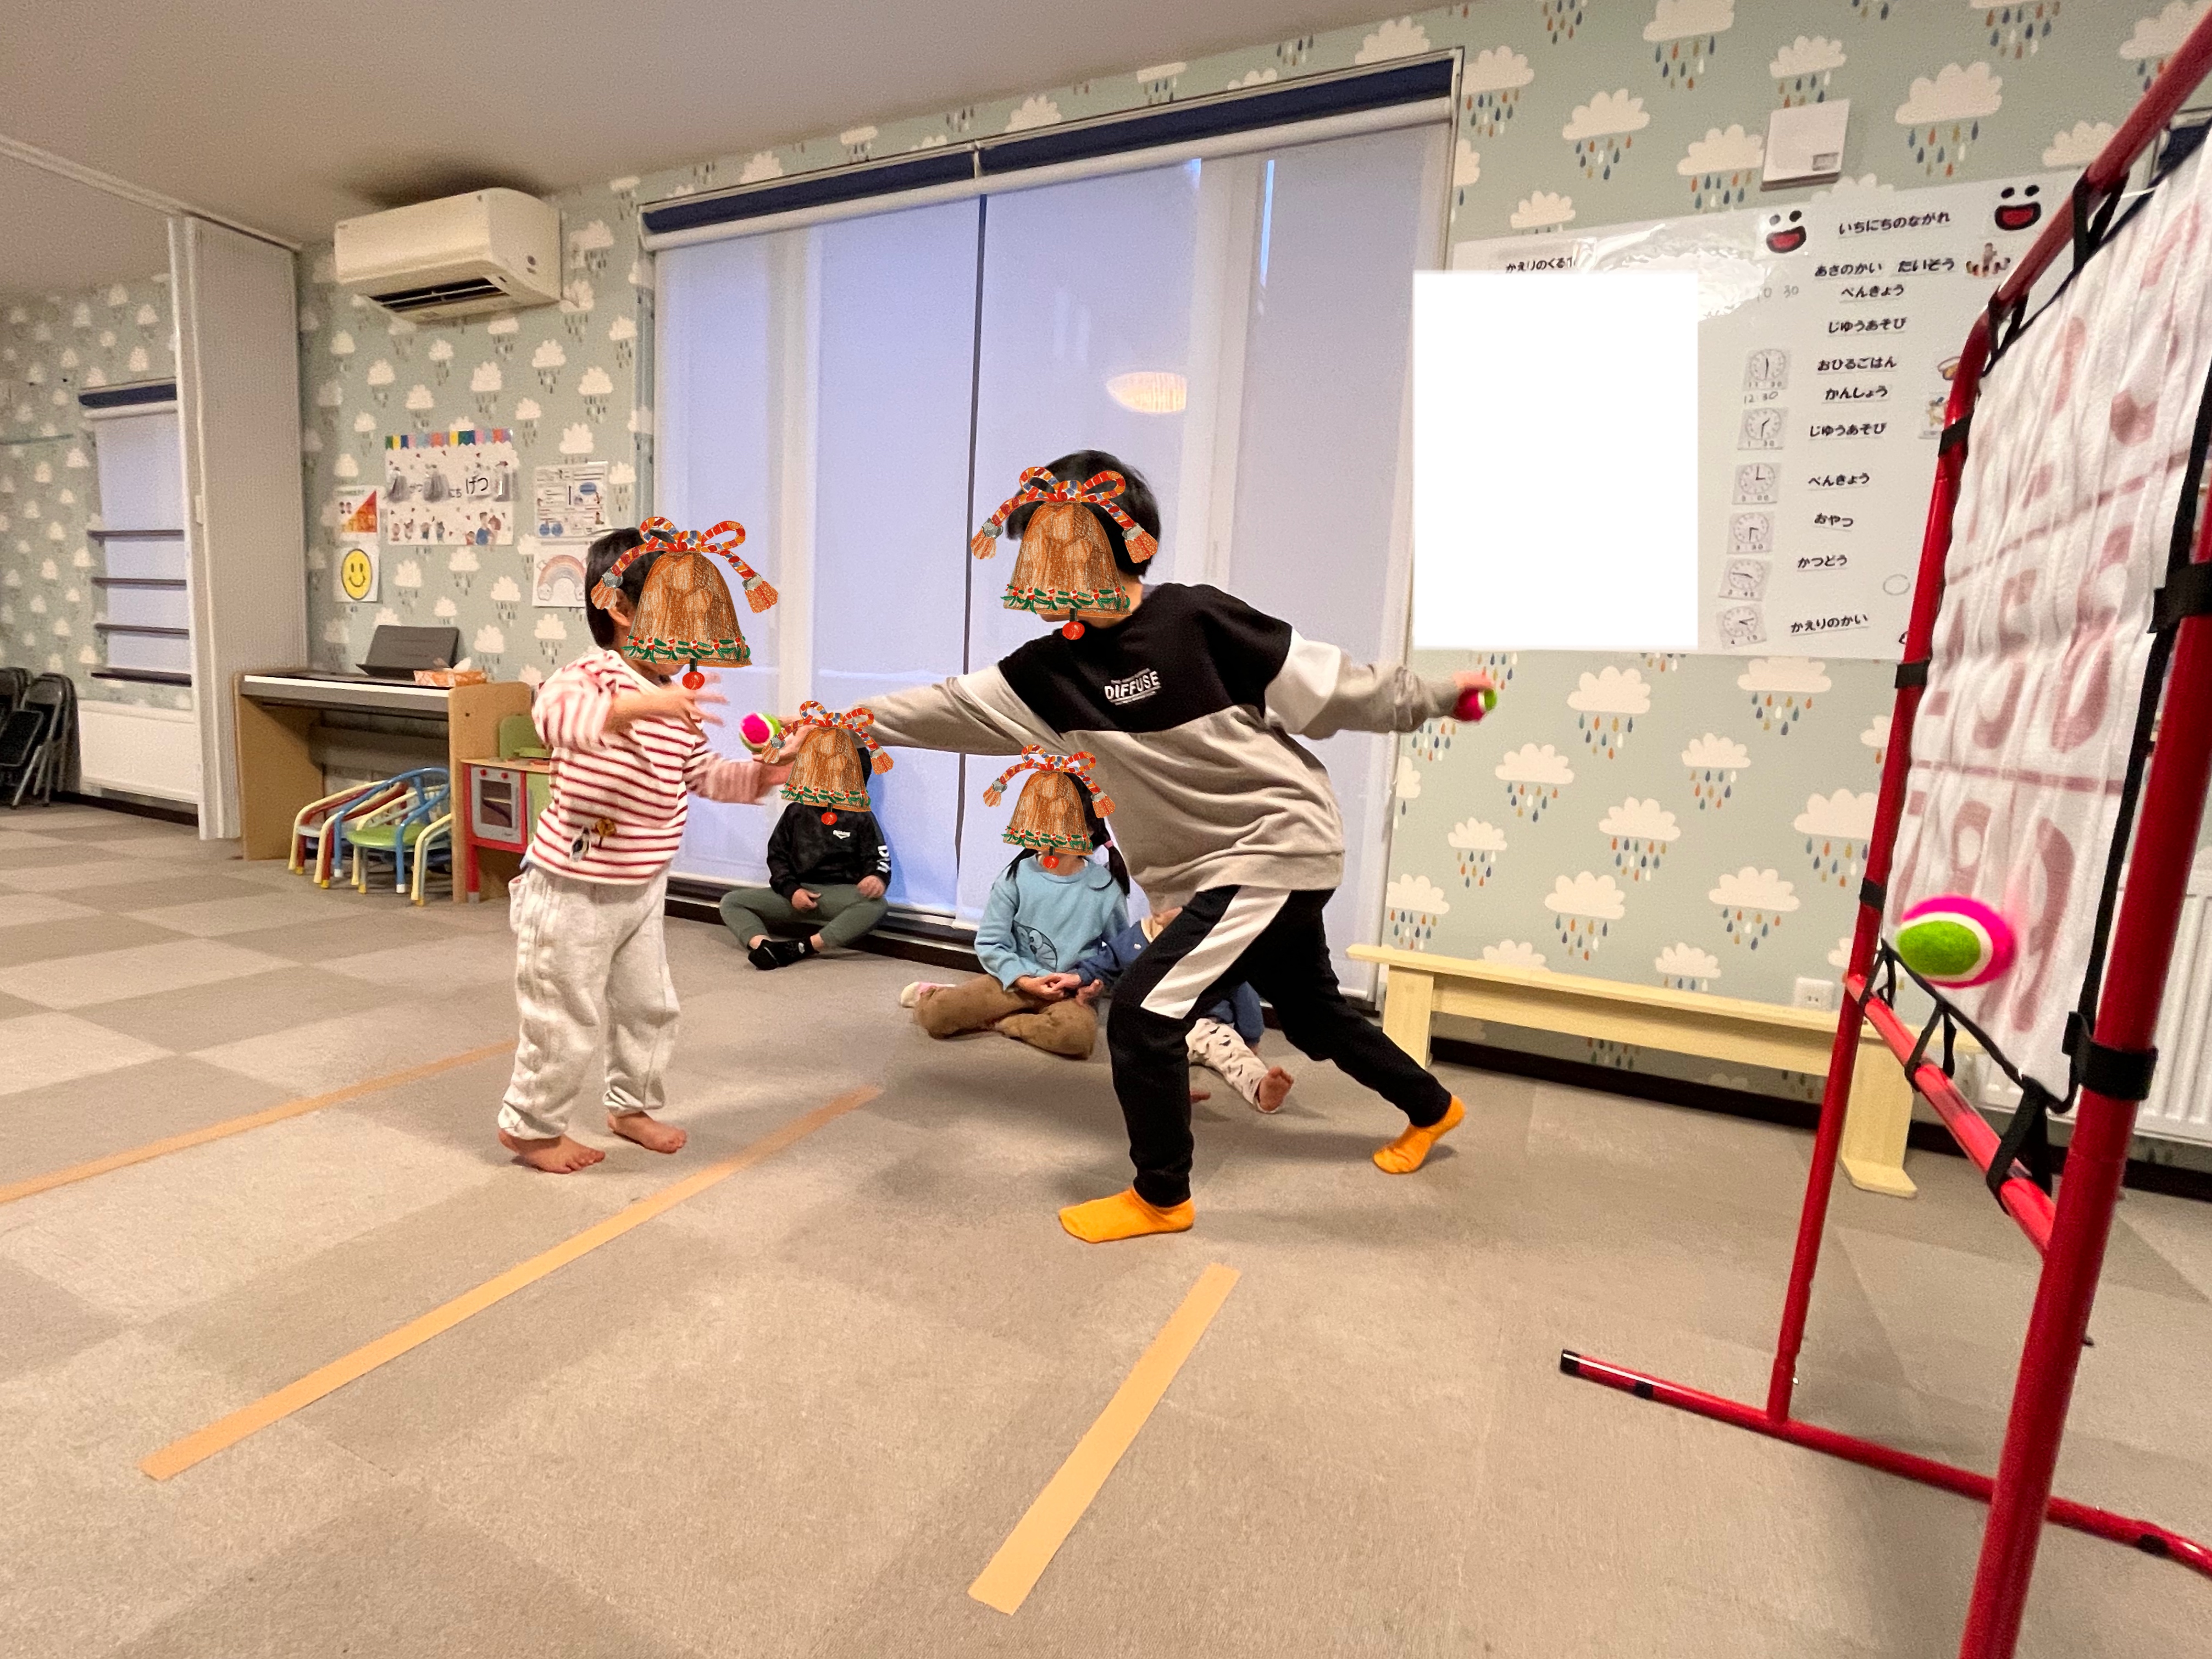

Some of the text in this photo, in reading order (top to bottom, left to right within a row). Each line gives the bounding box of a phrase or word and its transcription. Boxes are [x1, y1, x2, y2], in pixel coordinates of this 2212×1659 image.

[1839, 212, 1950, 235] いちにちのながれ
[1815, 258, 1955, 277] あさのかい たいそう
[1841, 284, 1904, 297] べんきょう
[1828, 317, 1906, 333] じゆうあそび
[1817, 356, 1897, 371] おひるごはん
[1744, 394, 1754, 404] 12
[1825, 386, 1888, 401] かんしょう
[1810, 423, 1886, 437] じゆうあそび
[465, 476, 489, 495] げつ
[1808, 472, 1870, 487] べんきょう
[1815, 513, 1854, 528] おやつ
[1798, 555, 1848, 568] かつどう
[1790, 614, 1868, 632] かえりのかい
[1104, 671, 1161, 700] DIFFUSE
